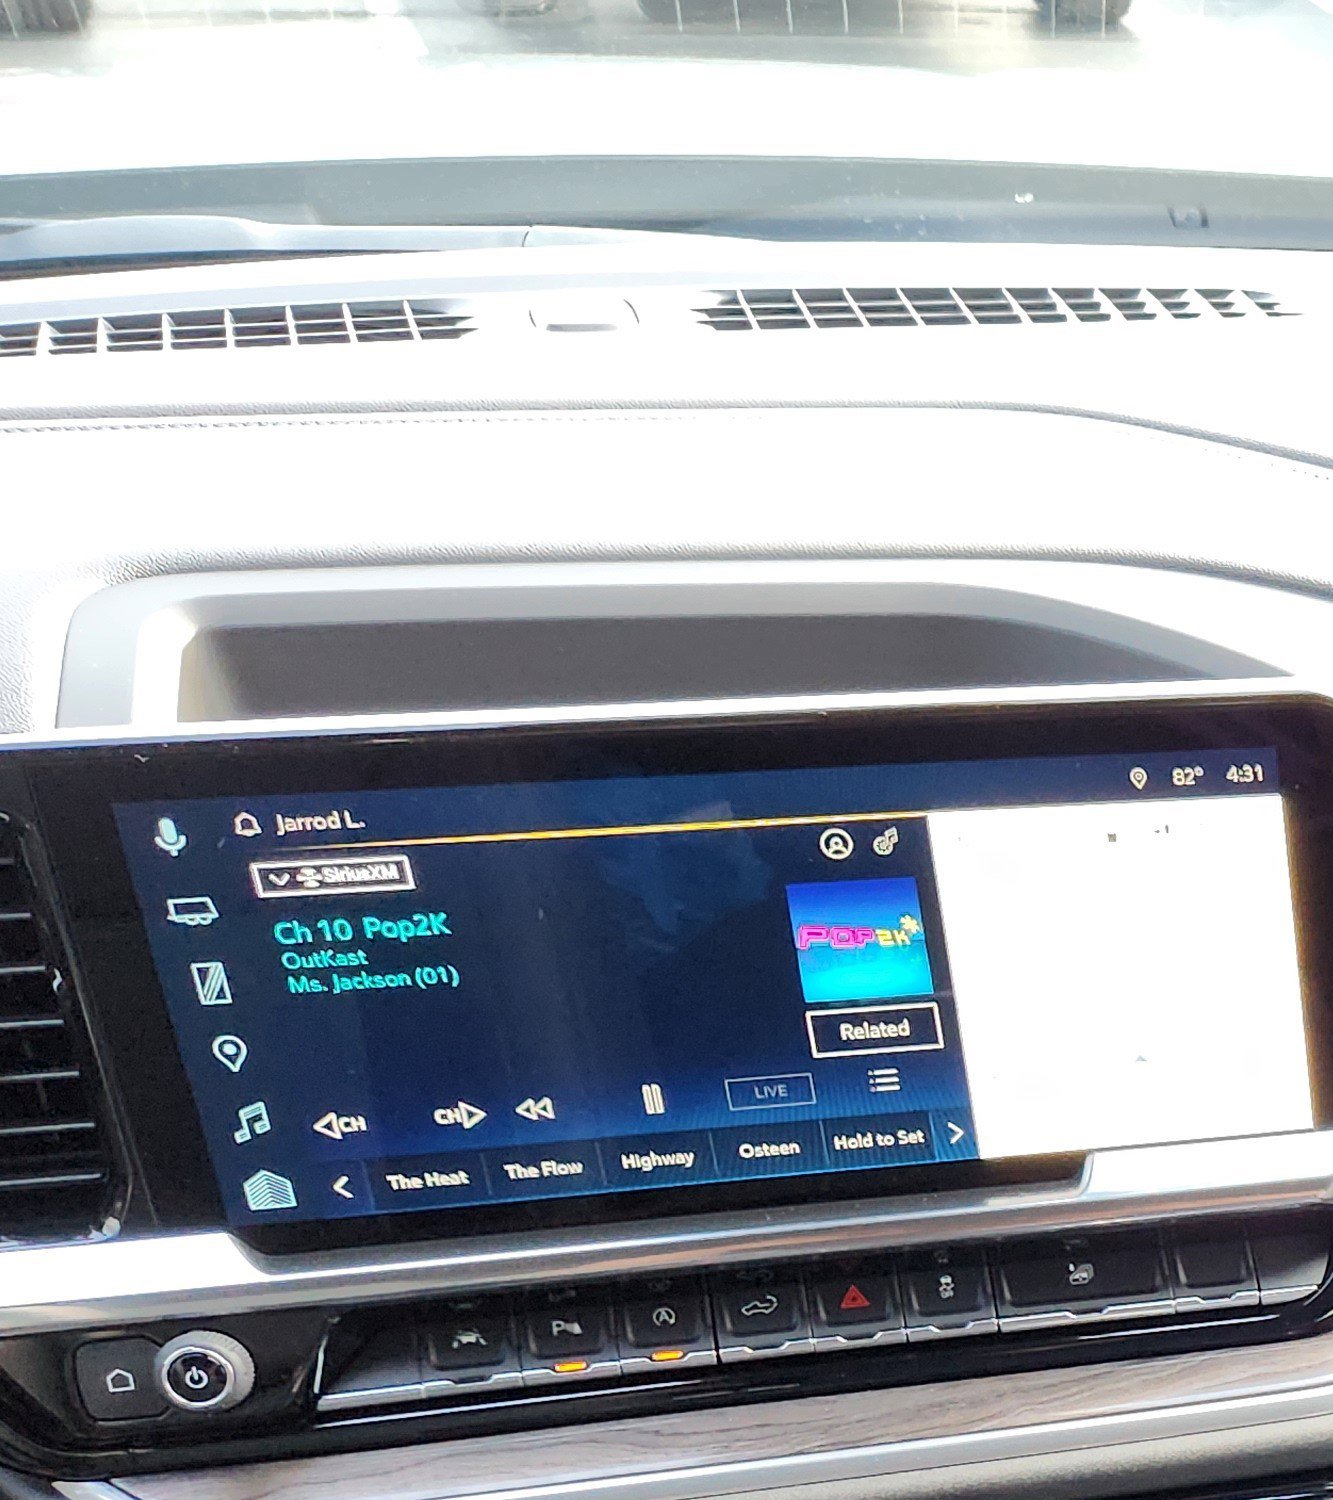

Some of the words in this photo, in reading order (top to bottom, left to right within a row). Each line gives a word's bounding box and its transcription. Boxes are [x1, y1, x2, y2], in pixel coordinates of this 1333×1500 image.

[1225, 763, 1264, 783] 4:31
[275, 810, 342, 836] Jarrod
[343, 809, 366, 829] L.
[321, 862, 400, 883] SiriusXM
[273, 920, 313, 944] Ch
[317, 918, 354, 942] 10
[361, 912, 453, 943] Pop2K
[280, 948, 369, 970] OutKast
[286, 975, 329, 994] Ms.
[331, 970, 412, 995] Jackson
[414, 964, 460, 989] (01)
[838, 1017, 911, 1041] Related
[754, 1083, 789, 1100] LIVE
[338, 1115, 367, 1133] CH
[433, 1107, 460, 1125] CH
[738, 1140, 801, 1159] Osteen
[833, 1131, 874, 1151] Hold
[875, 1131, 893, 1148] to
[896, 1128, 927, 1147] Set
[502, 1161, 541, 1181] The
[541, 1159, 584, 1178] Flow
[620, 1149, 696, 1173] Highway
[385, 1173, 424, 1192] The
[426, 1169, 471, 1188] Heat
